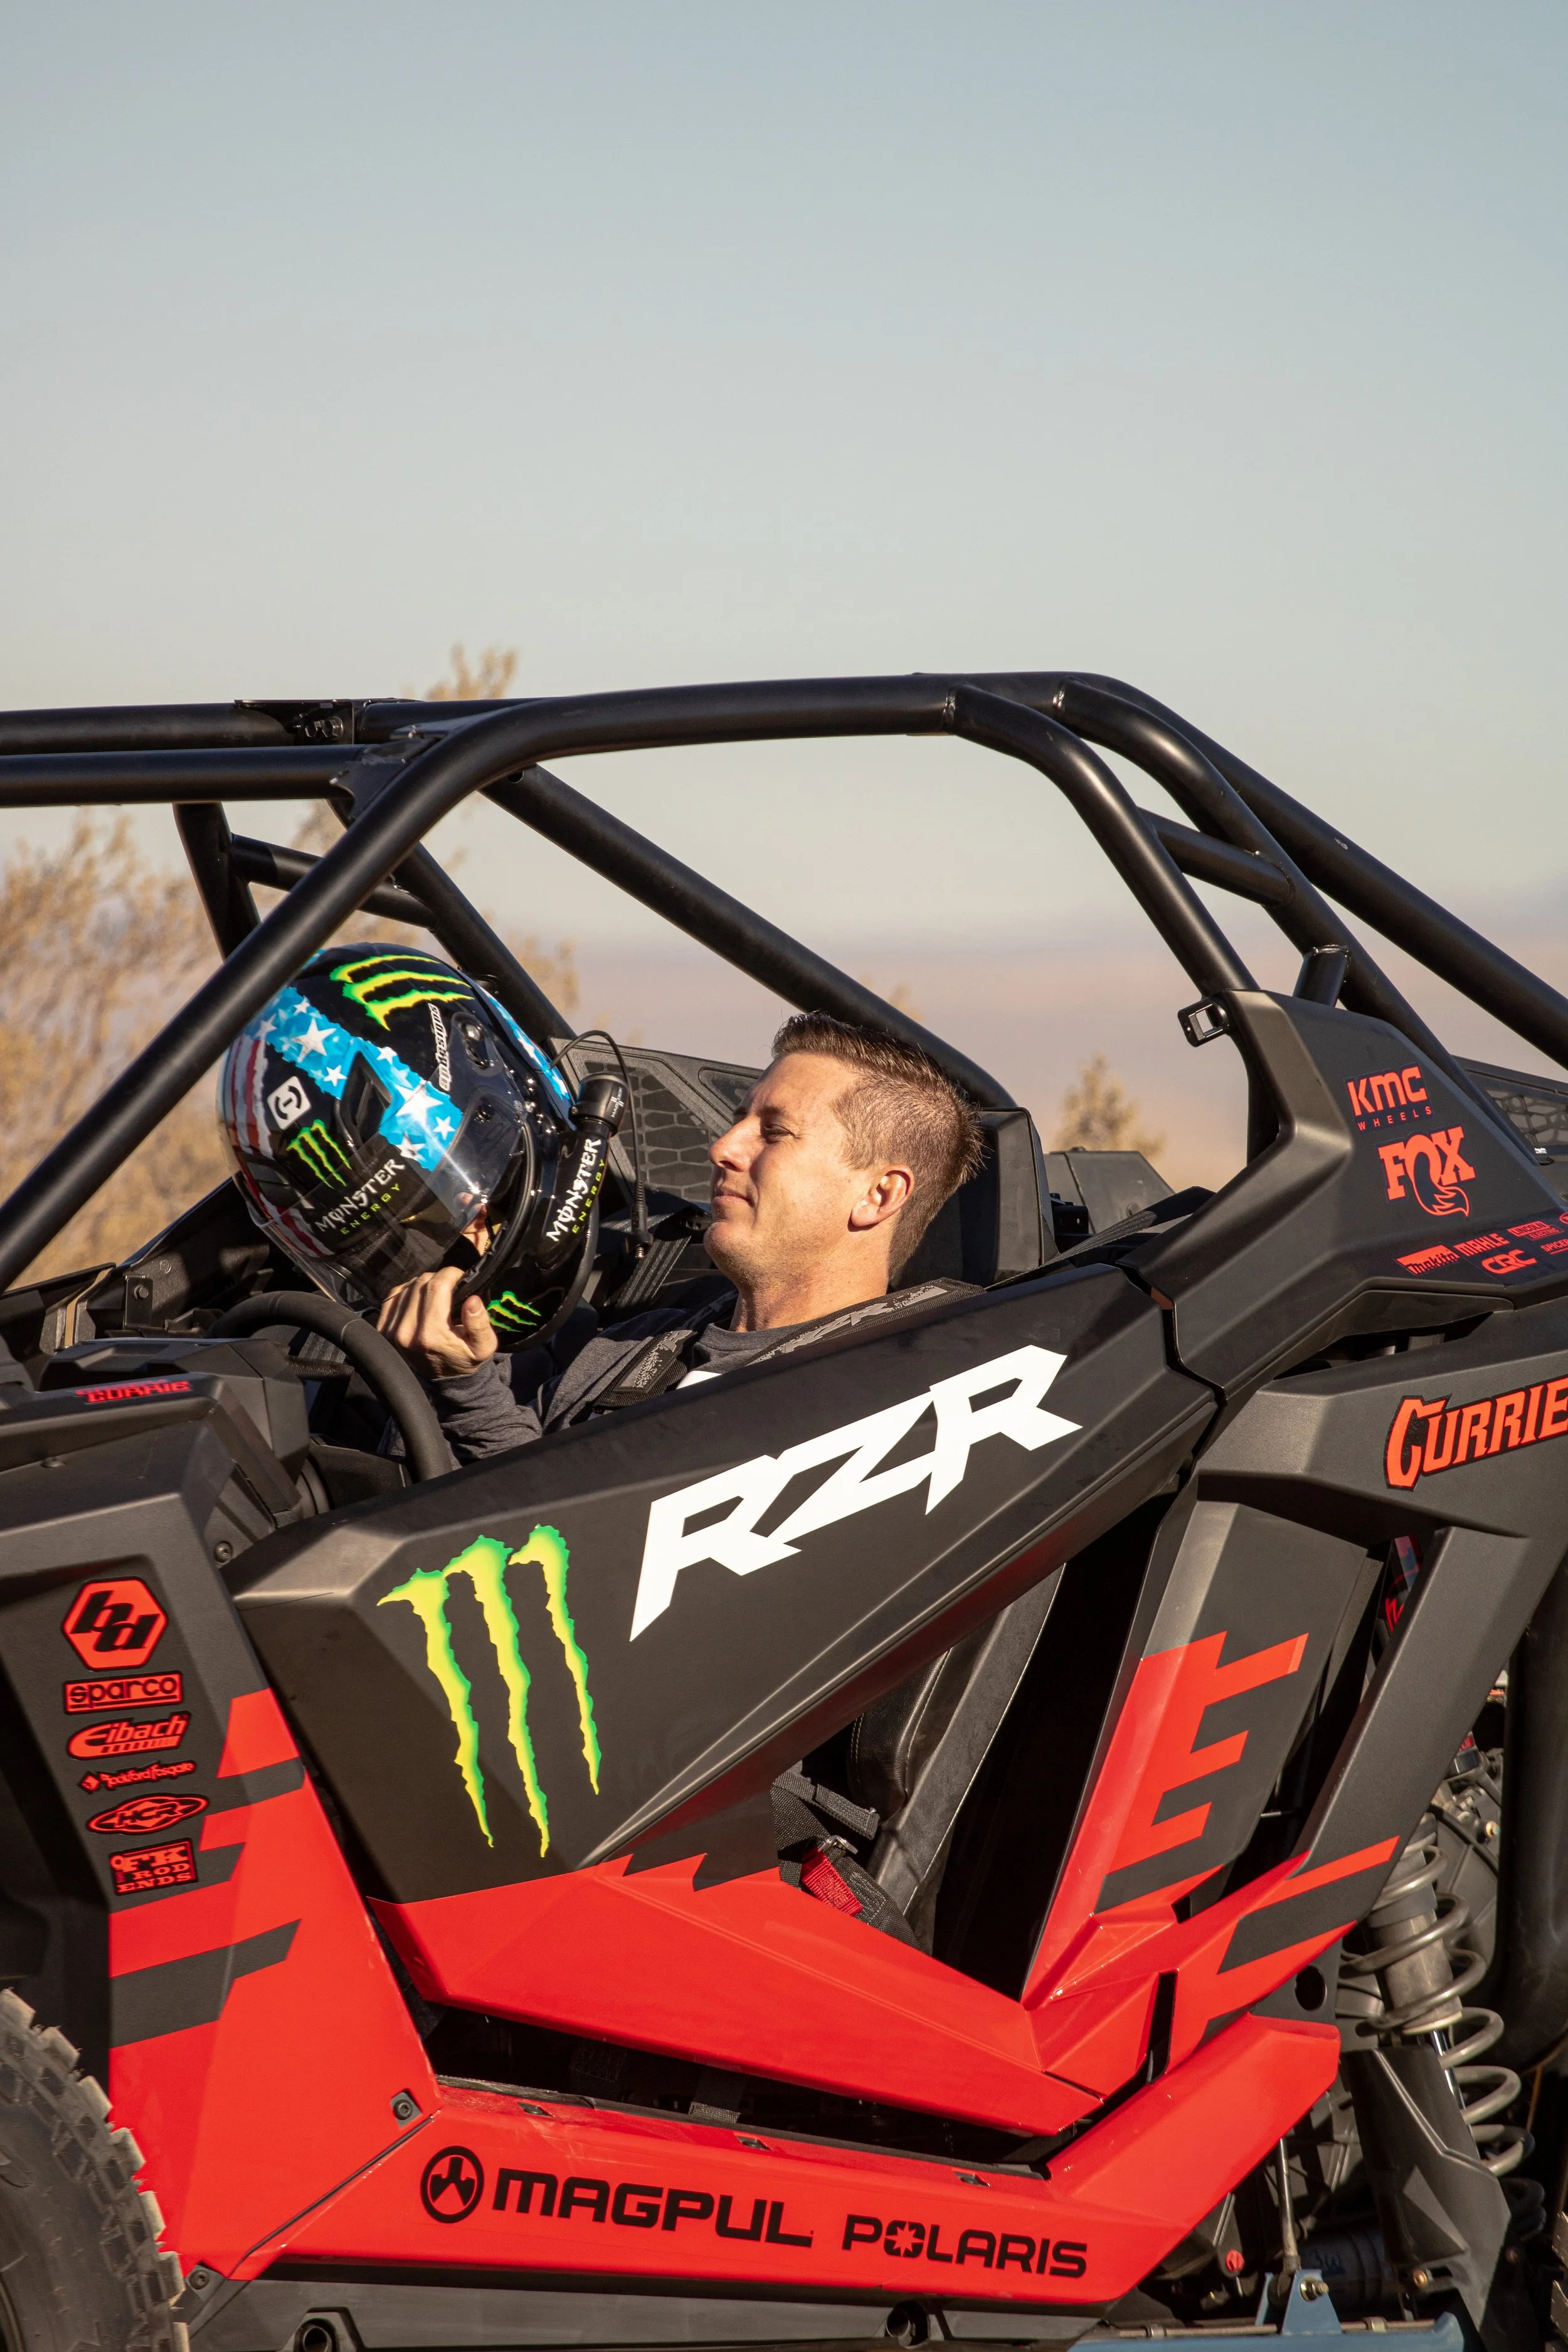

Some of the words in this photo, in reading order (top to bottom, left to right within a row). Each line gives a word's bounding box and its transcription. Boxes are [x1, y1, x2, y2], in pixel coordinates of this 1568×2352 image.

[1357, 1106, 1433, 1131] WHEELS
[546, 1138, 601, 1242] MONSTER
[1378, 1126, 1476, 1217] FOX
[315, 1158, 406, 1232] MONSTER
[340, 1183, 400, 1235] ENERGY
[571, 1158, 605, 1234] ENERGY
[1453, 1232, 1510, 1257] MAHLE
[1511, 1222, 1545, 1235] LINCOLN
[1481, 1249, 1537, 1274] CRC
[1387, 1376, 1568, 1488] CURRIE
[630, 1344, 1084, 1642] RZR
[70, 1677, 178, 1708] sparco
[69, 1714, 188, 1757] Eibach
[118, 1803, 181, 1825] HCR
[117, 1872, 192, 1893] ENDS
[132, 1863, 190, 1880] ROD
[492, 2167, 809, 2247] MAGPUL
[842, 2213, 1087, 2278] POLARIS
